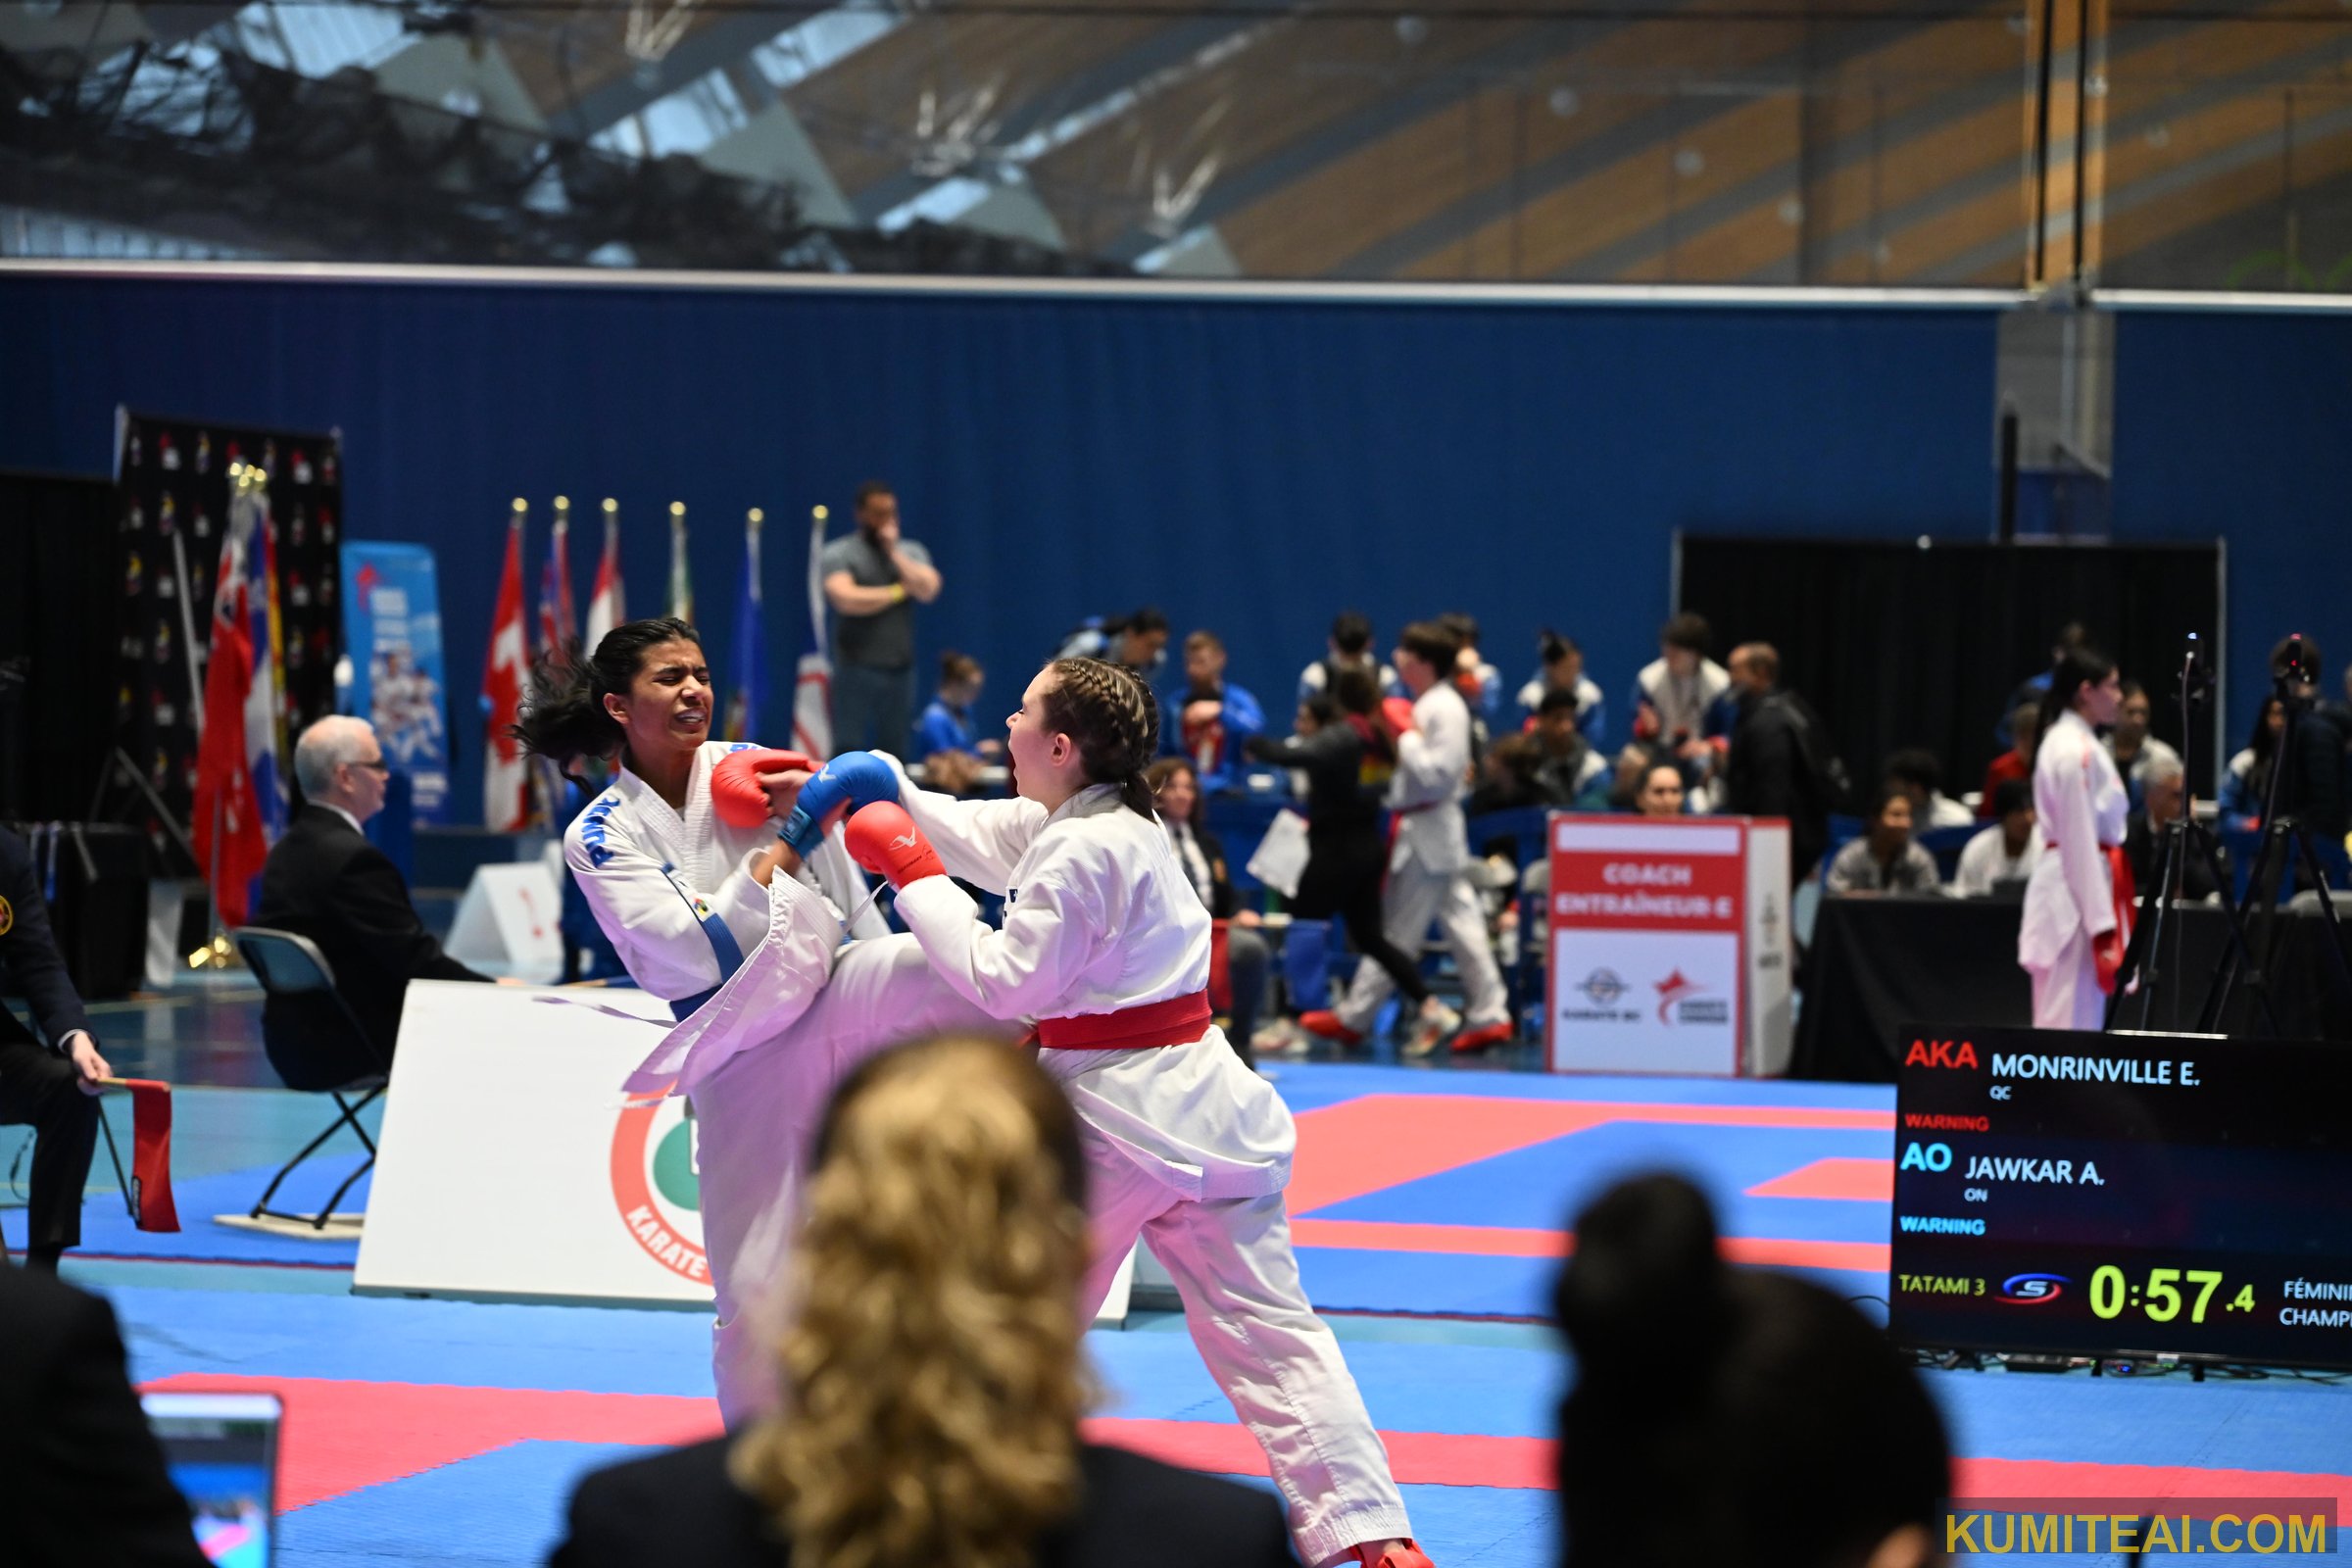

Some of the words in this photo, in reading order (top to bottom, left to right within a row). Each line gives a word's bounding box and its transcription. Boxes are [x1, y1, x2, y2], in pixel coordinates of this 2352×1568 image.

[1602, 862, 1692, 887] COACH
[1905, 1040, 1979, 1070] AKA
[1991, 1053, 2172, 1085] MONRINVILLE
[2180, 1061, 2201, 1086] E.
[1989, 1085, 2012, 1101] QC
[1904, 1113, 1989, 1132] WARNING
[1900, 1142, 1952, 1172] AO
[1964, 1156, 2073, 1184] JAWKAR
[2079, 1161, 2105, 1186] A.
[1964, 1188, 1988, 1202] ON
[1899, 1215, 1985, 1236] WARNING
[627, 1204, 708, 1278] KARATE
[1899, 1274, 1970, 1296] TATAMI
[1974, 1278, 1985, 1297] 3
[2284, 1277, 2352, 1301] FÉMINI
